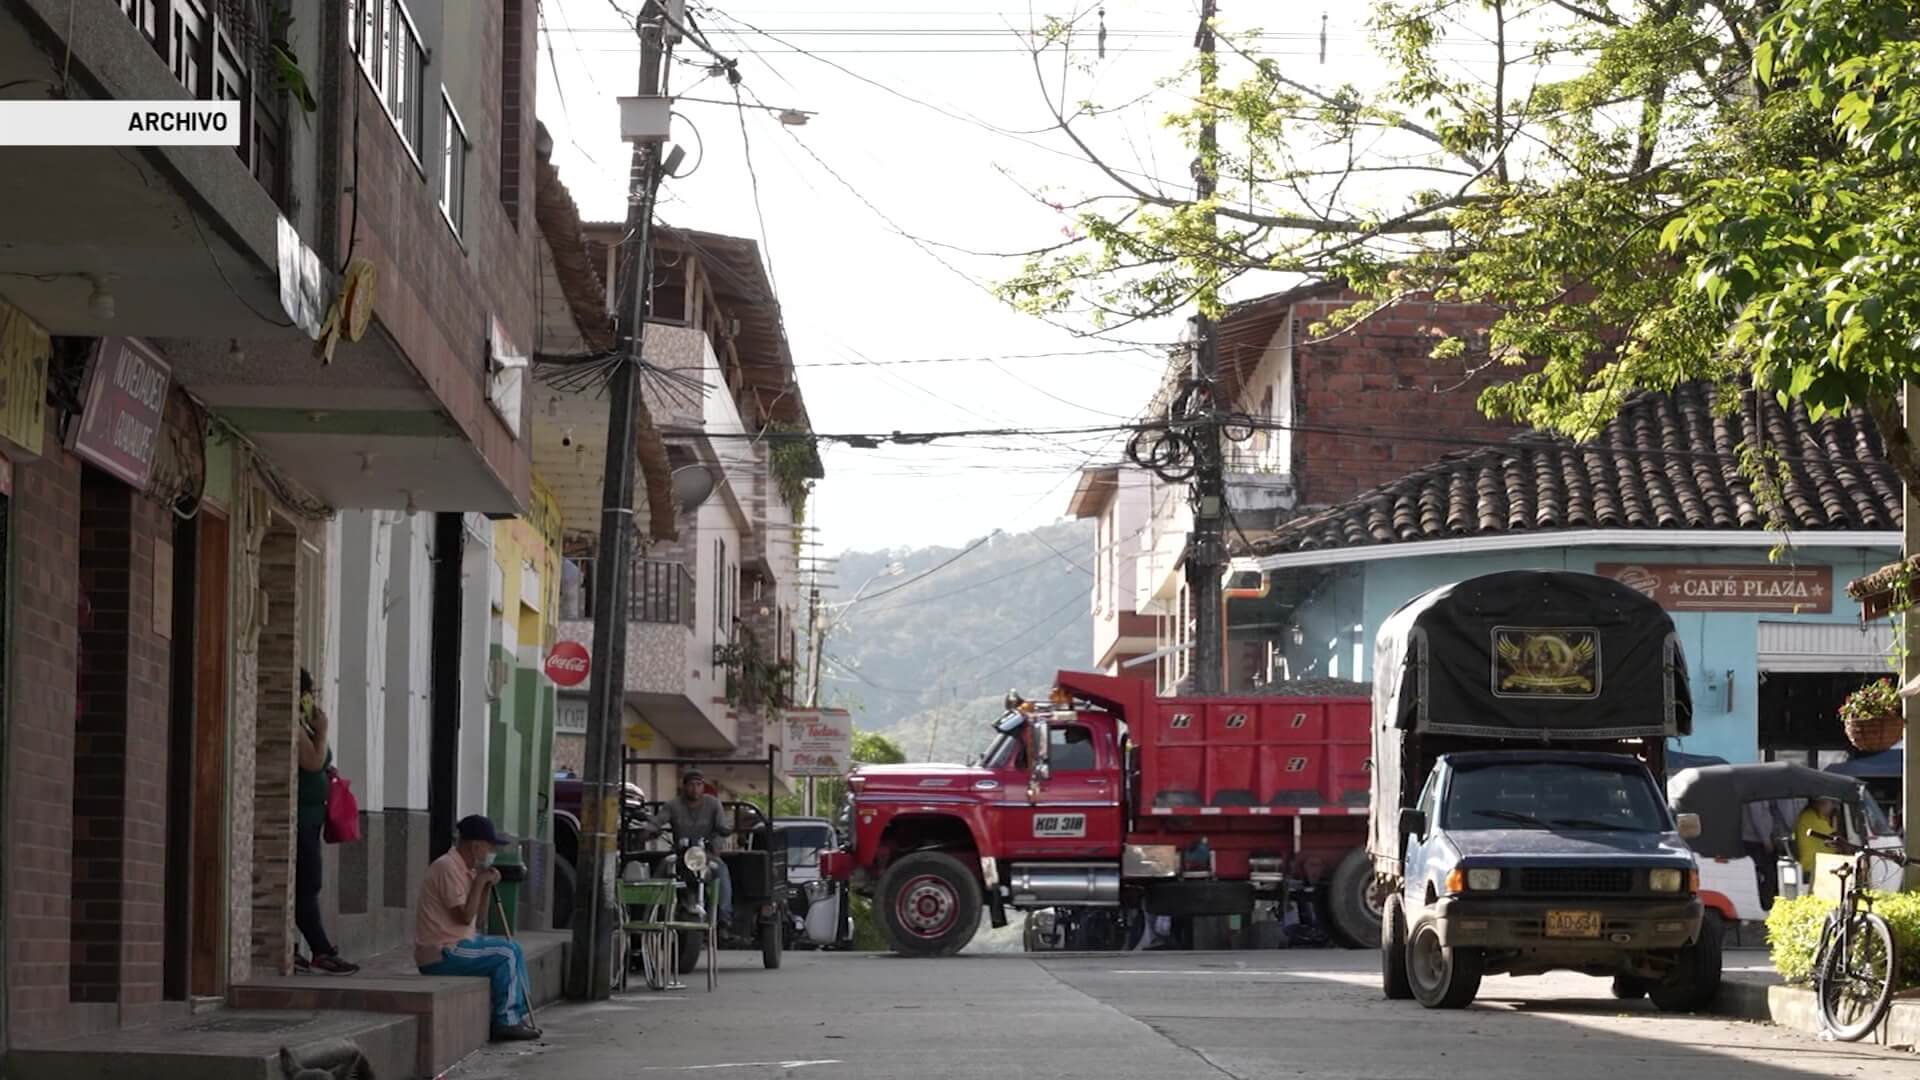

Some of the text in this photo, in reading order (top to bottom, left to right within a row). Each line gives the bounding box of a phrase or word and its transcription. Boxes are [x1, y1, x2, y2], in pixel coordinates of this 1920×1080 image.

[113, 343, 166, 412] NOVEDADES
[1684, 575, 1808, 597] CAFÉ PLAZA
[1035, 816, 1059, 831] KCI
